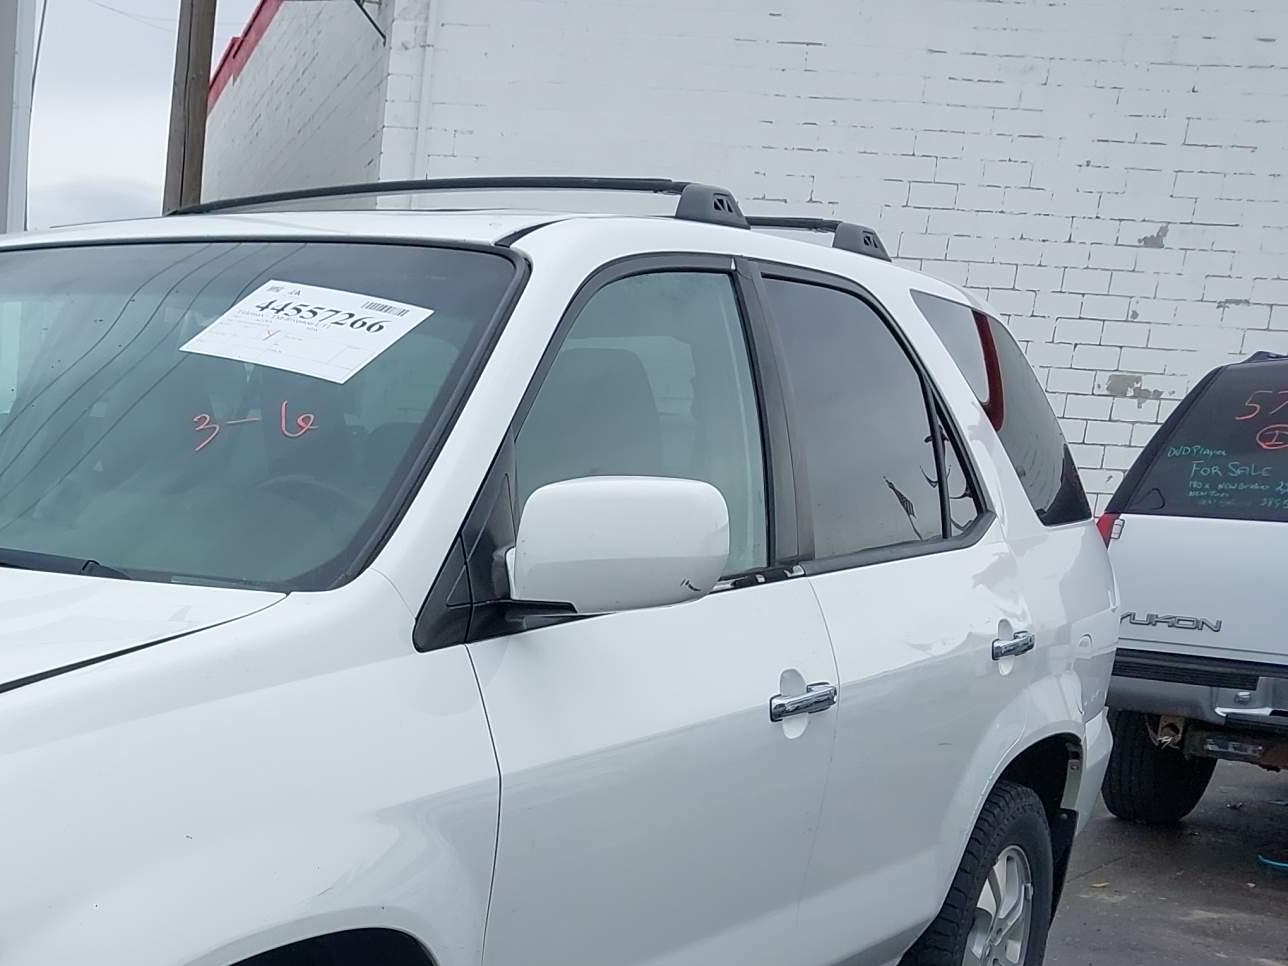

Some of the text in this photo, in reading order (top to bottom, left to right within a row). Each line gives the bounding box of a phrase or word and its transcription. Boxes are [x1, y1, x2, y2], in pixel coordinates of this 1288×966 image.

[255, 299, 393, 334] 44557266
[1191, 460, 1273, 478] FOR SALE
